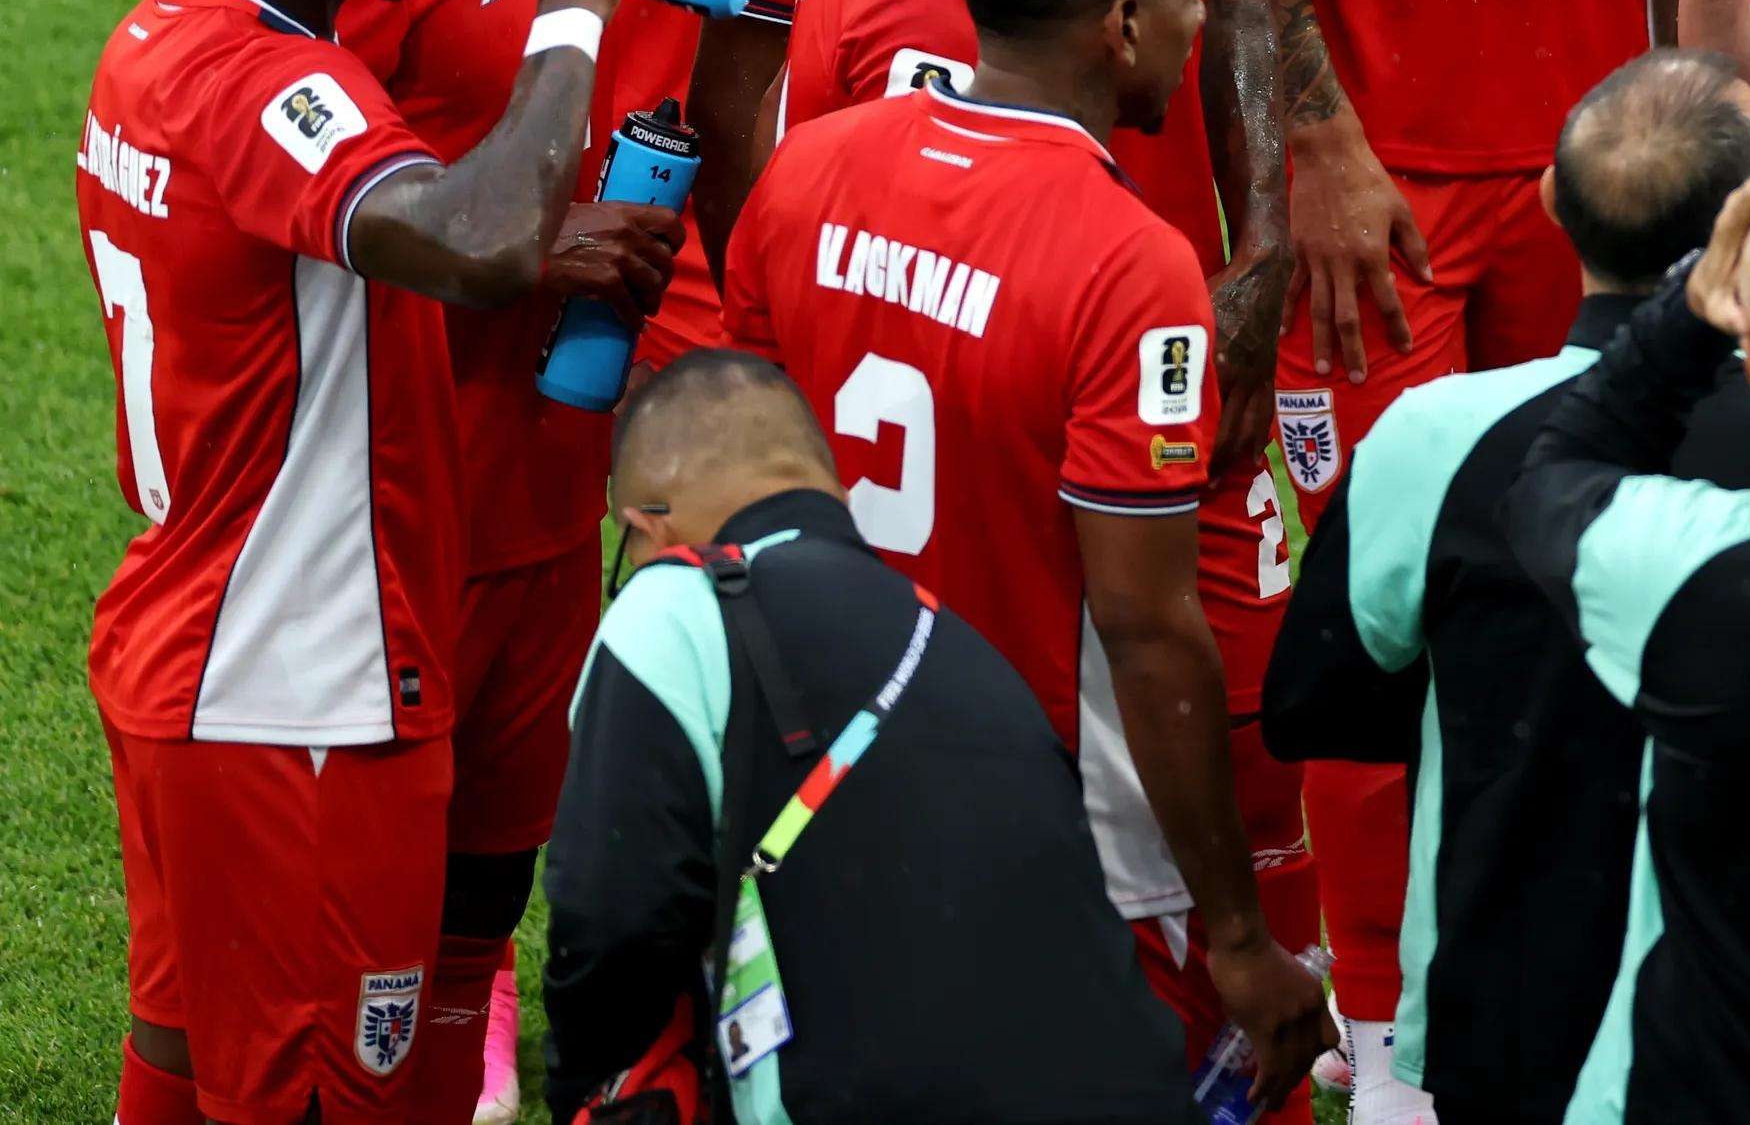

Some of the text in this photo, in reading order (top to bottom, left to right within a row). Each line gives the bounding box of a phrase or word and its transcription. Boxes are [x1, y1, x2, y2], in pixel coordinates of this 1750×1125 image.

[630, 125, 691, 154] POWERADE
[650, 165, 672, 183] 14
[89, 230, 171, 527] 7
[1278, 395, 1326, 409] PANAMÁ
[368, 972, 420, 991] PANAMÁ
